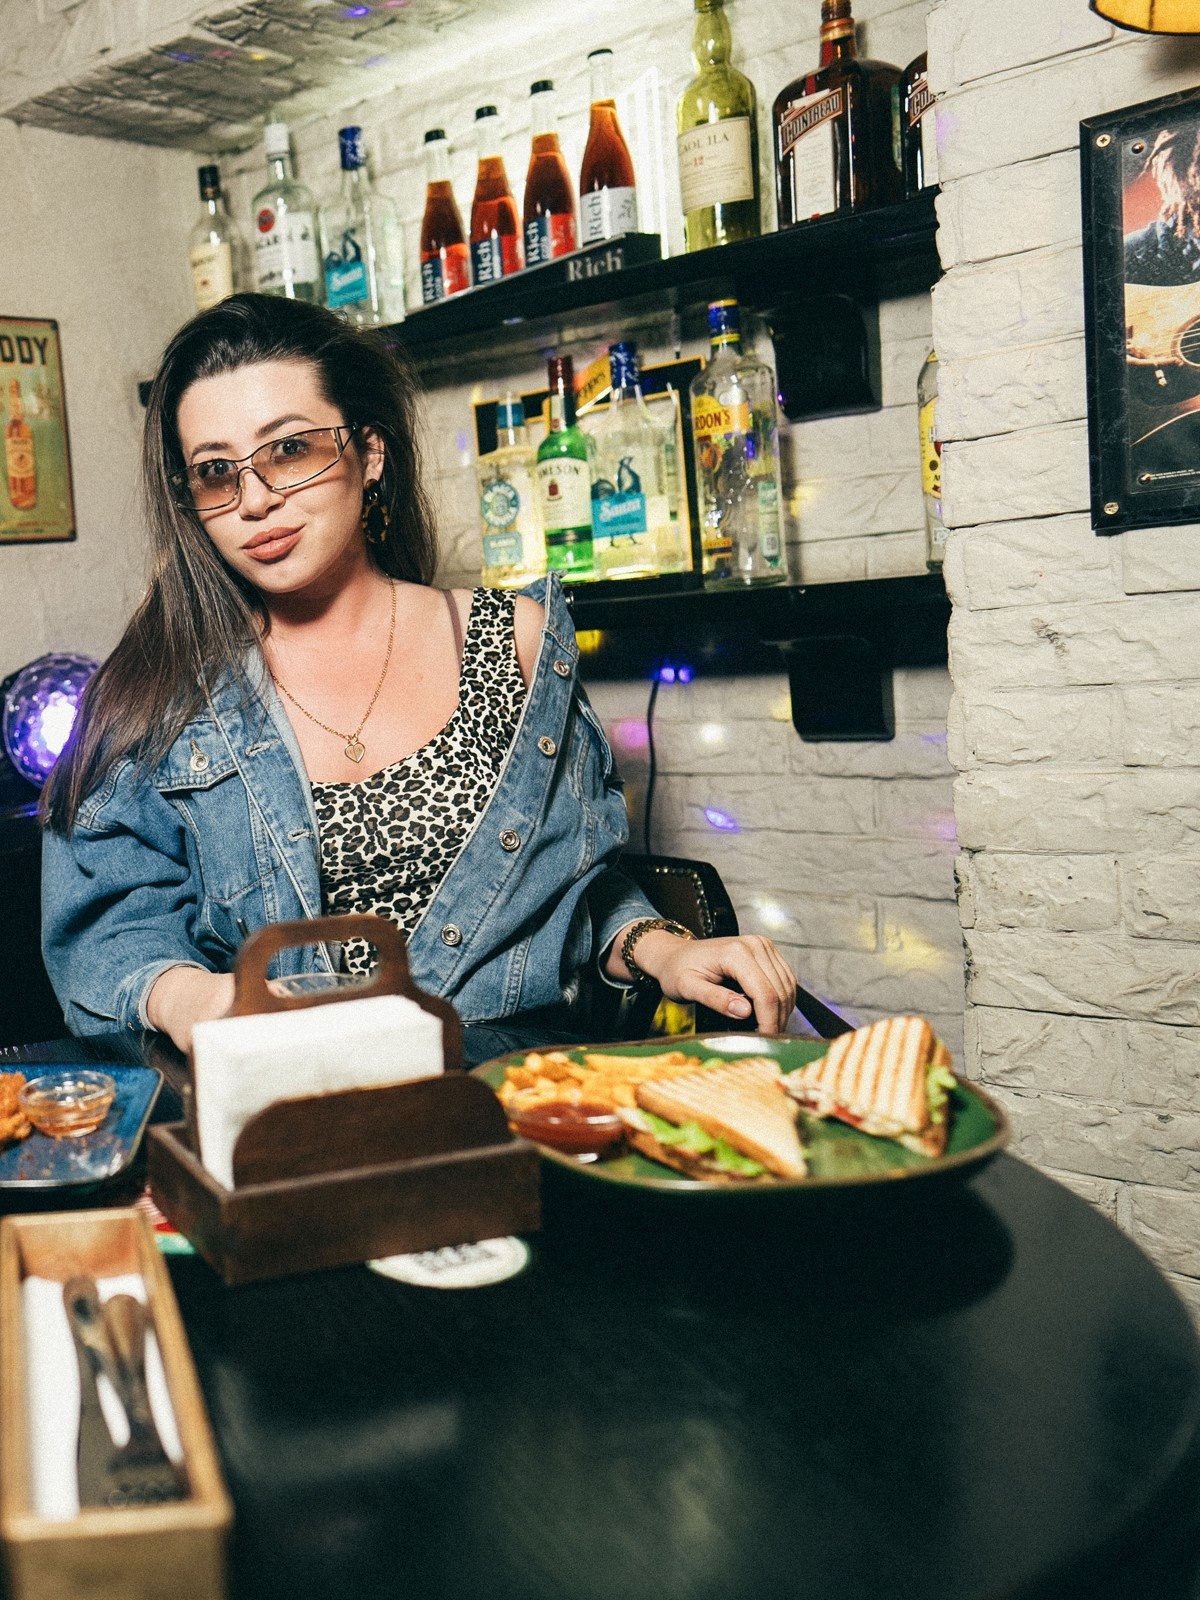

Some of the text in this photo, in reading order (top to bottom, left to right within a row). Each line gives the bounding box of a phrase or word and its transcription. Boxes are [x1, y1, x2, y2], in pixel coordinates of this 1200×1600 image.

[589, 196, 602, 237] Rich
[477, 240, 492, 282] Rich
[526, 221, 540, 263] Rich
[567, 248, 623, 282] Rich
[694, 408, 730, 431] RDON'S
